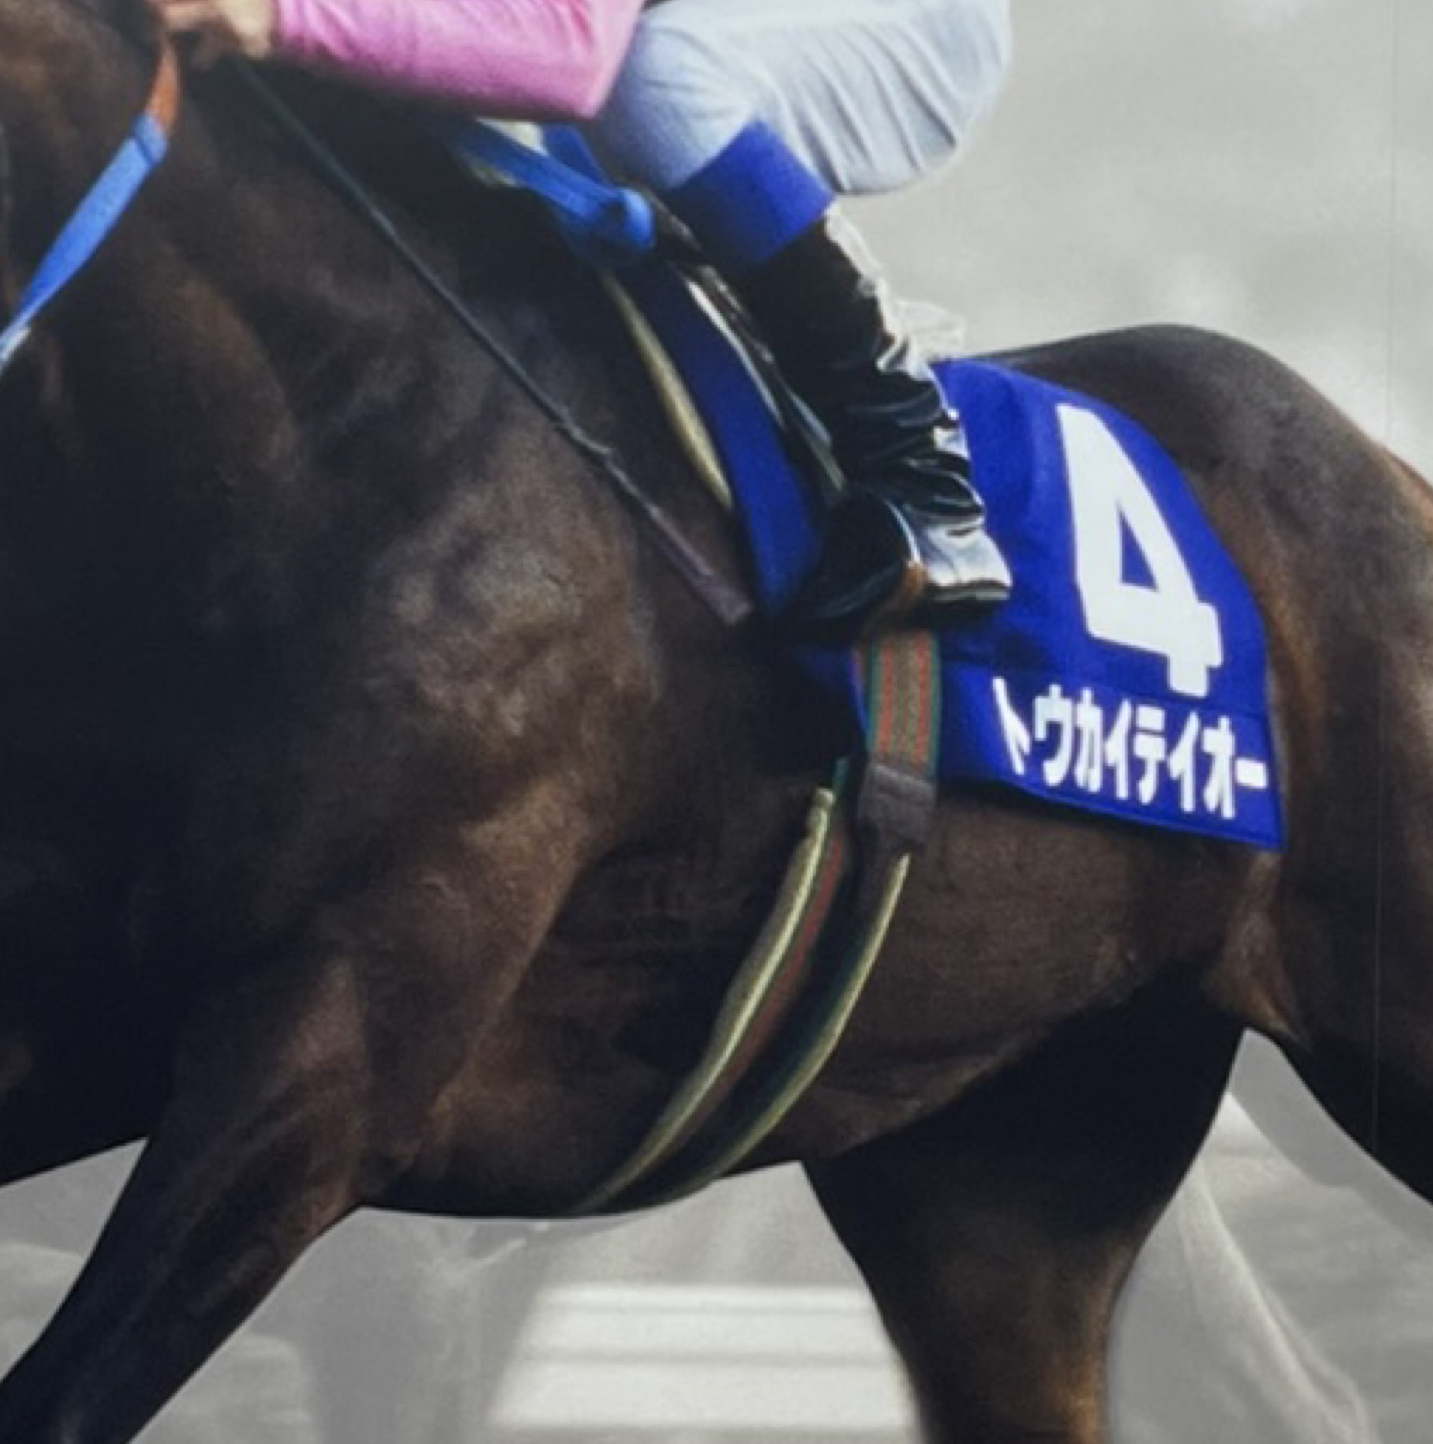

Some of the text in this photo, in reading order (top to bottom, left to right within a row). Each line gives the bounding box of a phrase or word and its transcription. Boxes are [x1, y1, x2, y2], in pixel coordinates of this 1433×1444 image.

[1056, 403, 1223, 697] 4
[993, 676, 1268, 818] トウカイテイオー
